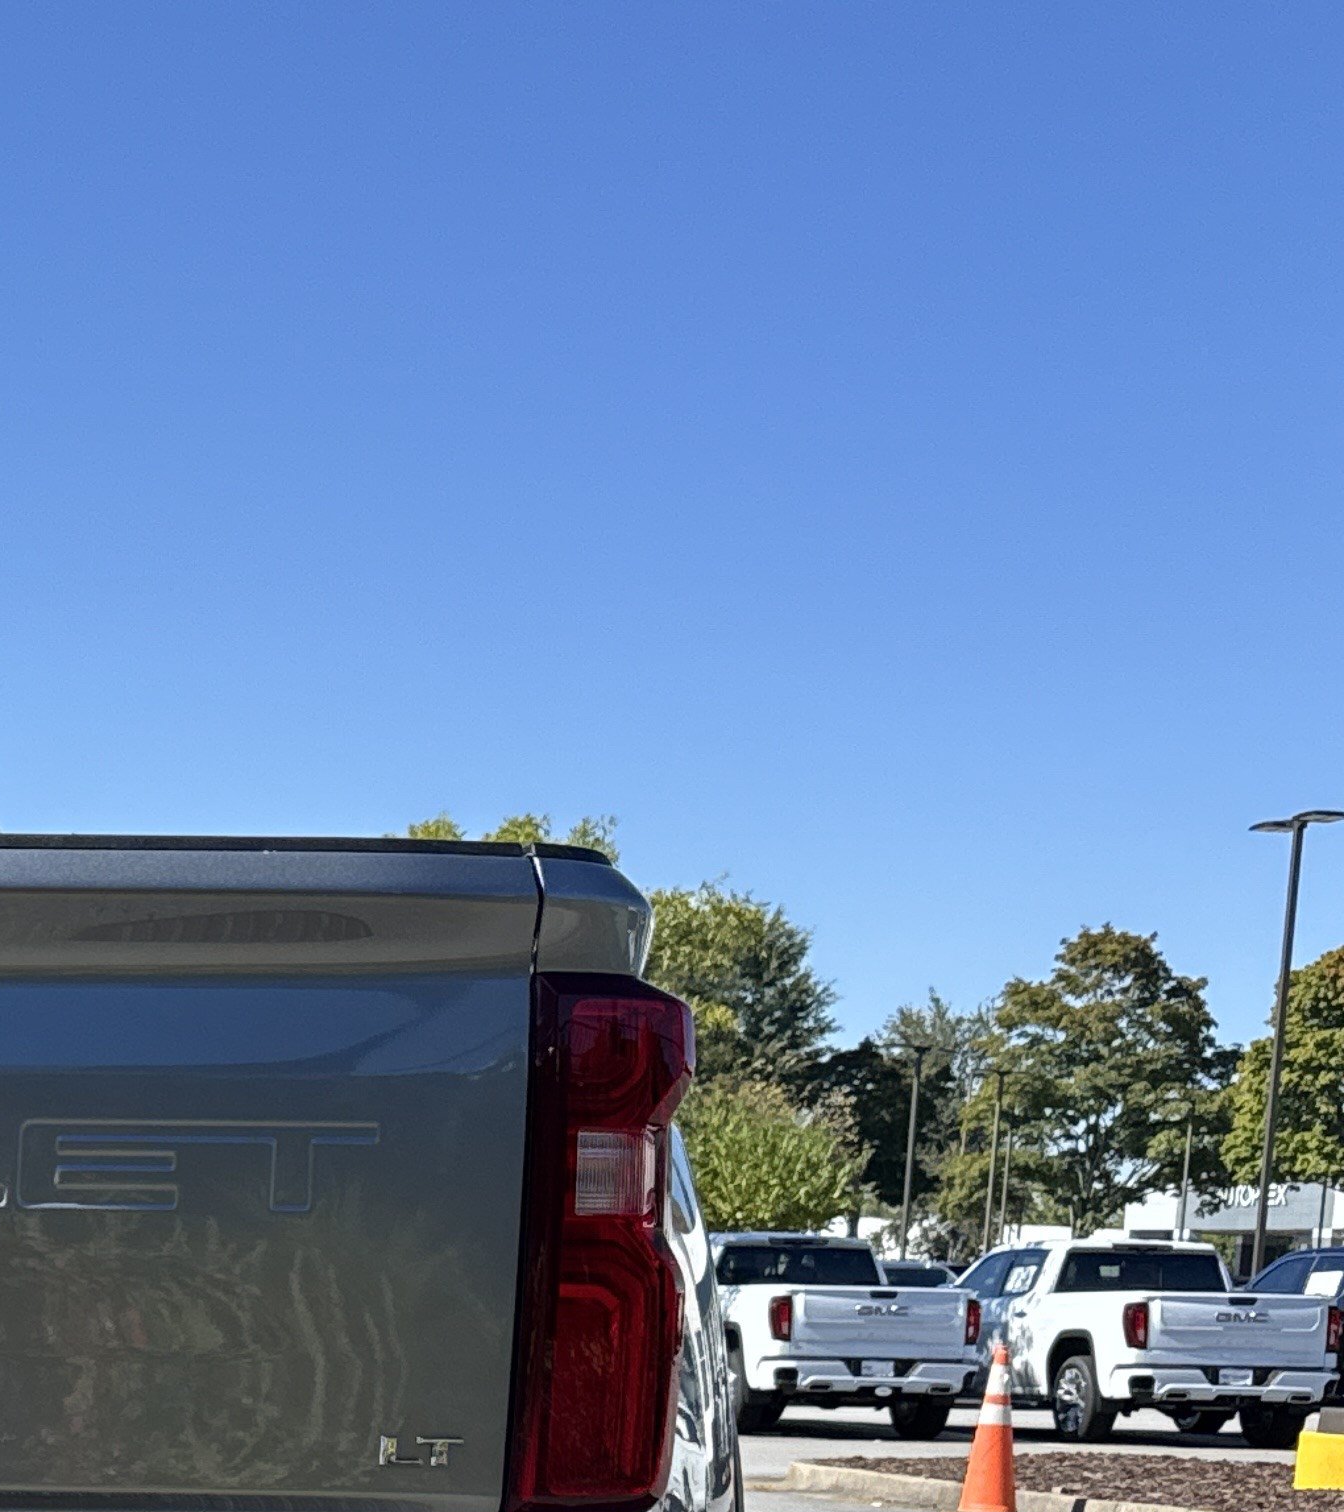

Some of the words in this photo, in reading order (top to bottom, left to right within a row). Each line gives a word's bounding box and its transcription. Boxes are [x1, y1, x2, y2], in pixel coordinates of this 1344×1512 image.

[855, 1304, 909, 1317] GMC
[1214, 1311, 1269, 1323] GMC
[378, 1435, 465, 1467] LT
